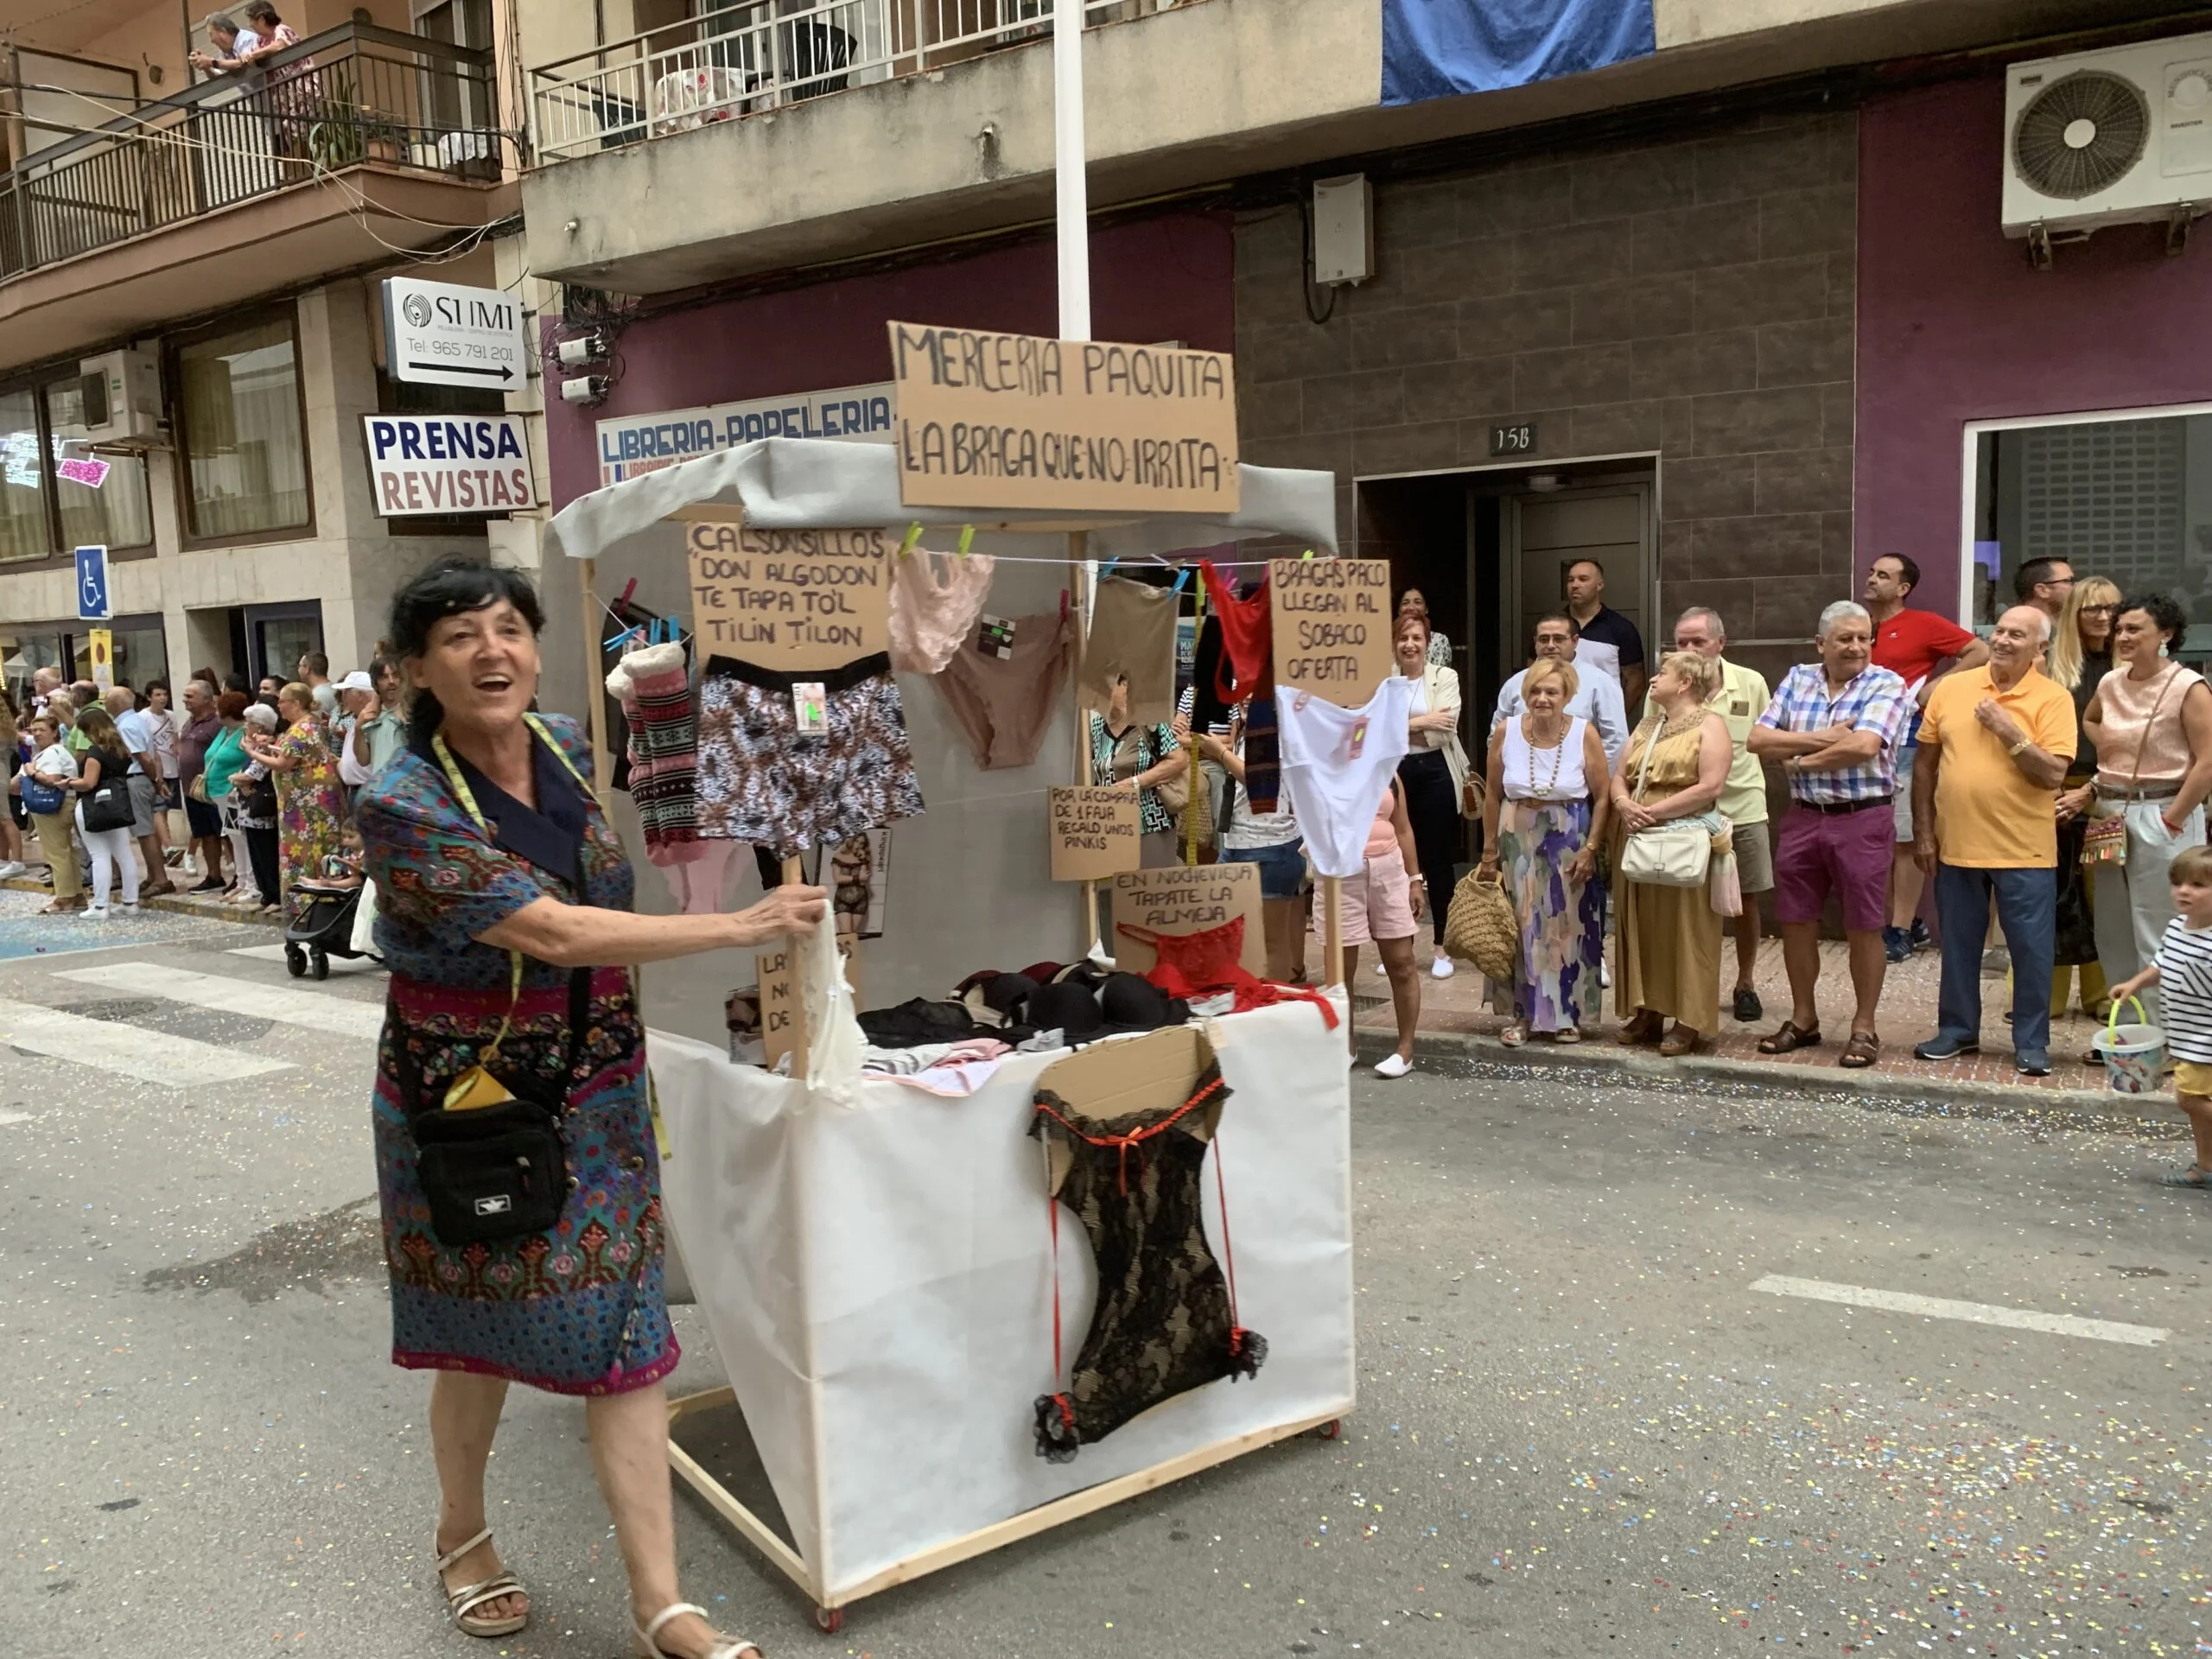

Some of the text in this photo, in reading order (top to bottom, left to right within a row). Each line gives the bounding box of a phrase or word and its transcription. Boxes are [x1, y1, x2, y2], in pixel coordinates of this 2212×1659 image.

[406, 338, 514, 361] Tel: 965 791 201
[896, 324, 1224, 400] MERCERIA PAQUITA
[372, 422, 523, 460] PRENSA
[1497, 427, 1529, 449] 15B
[952, 422, 1038, 478] BRAGA
[1042, 431, 1084, 481] QUE
[381, 469, 530, 510] REVISTAS
[1274, 561, 1385, 588] BRAGAS PACO
[695, 586, 727, 608] TE
[731, 588, 795, 613] TAPA
[1283, 592, 1379, 613] LLEGAN AL
[1299, 620, 1366, 650] SOBACO
[1287, 656, 1358, 681] OFERTA
[1052, 788, 1077, 804] POR
[1055, 804, 1116, 820] DE 1 FAJA
[1058, 821, 1135, 836] REGALO UNOS
[1065, 836, 1107, 850] PINKIS
[1116, 866, 1252, 888] EN NOCHEVIEJA
[1128, 887, 1232, 906] TAPATE LA
[1145, 906, 1226, 925] ALMEJA
